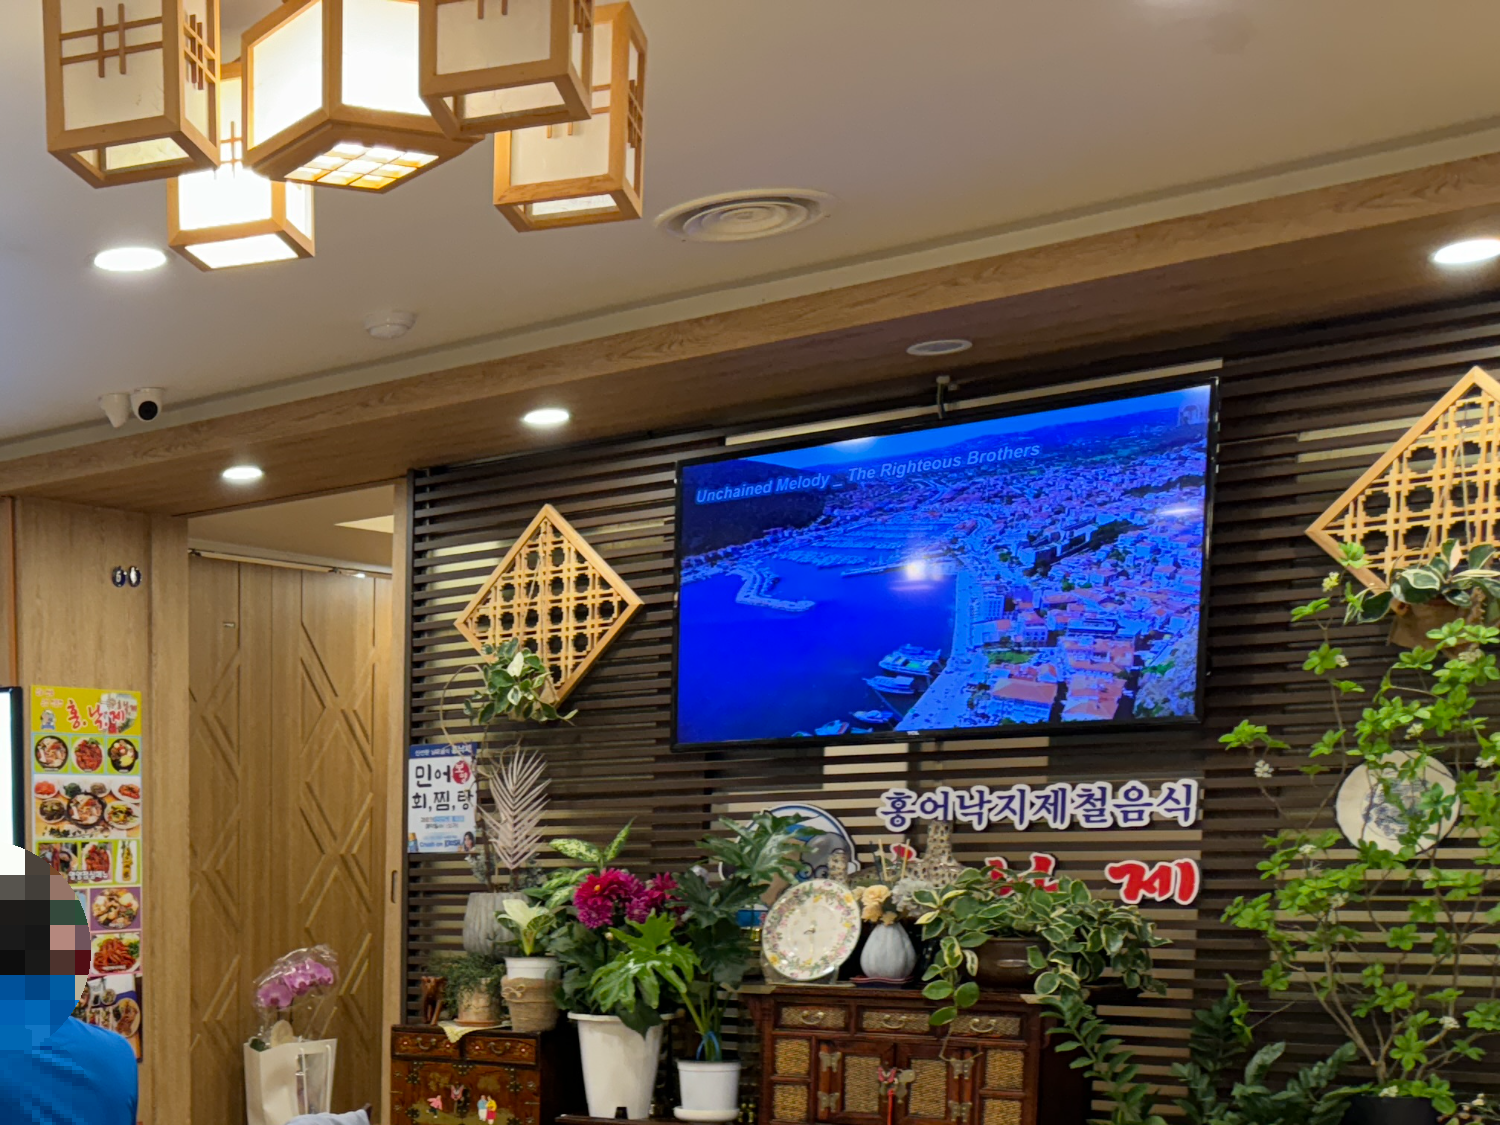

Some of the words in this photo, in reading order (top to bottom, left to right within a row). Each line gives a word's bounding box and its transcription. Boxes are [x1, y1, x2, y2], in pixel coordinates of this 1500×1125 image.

[696, 480, 773, 503] Unchained
[776, 473, 831, 492] Melody
[849, 467, 876, 482] The
[880, 455, 962, 479] Righteous
[967, 444, 1041, 465] Brothers
[415, 764, 451, 788] 민어
[880, 782, 1194, 829] 홍어낙지제철음식
